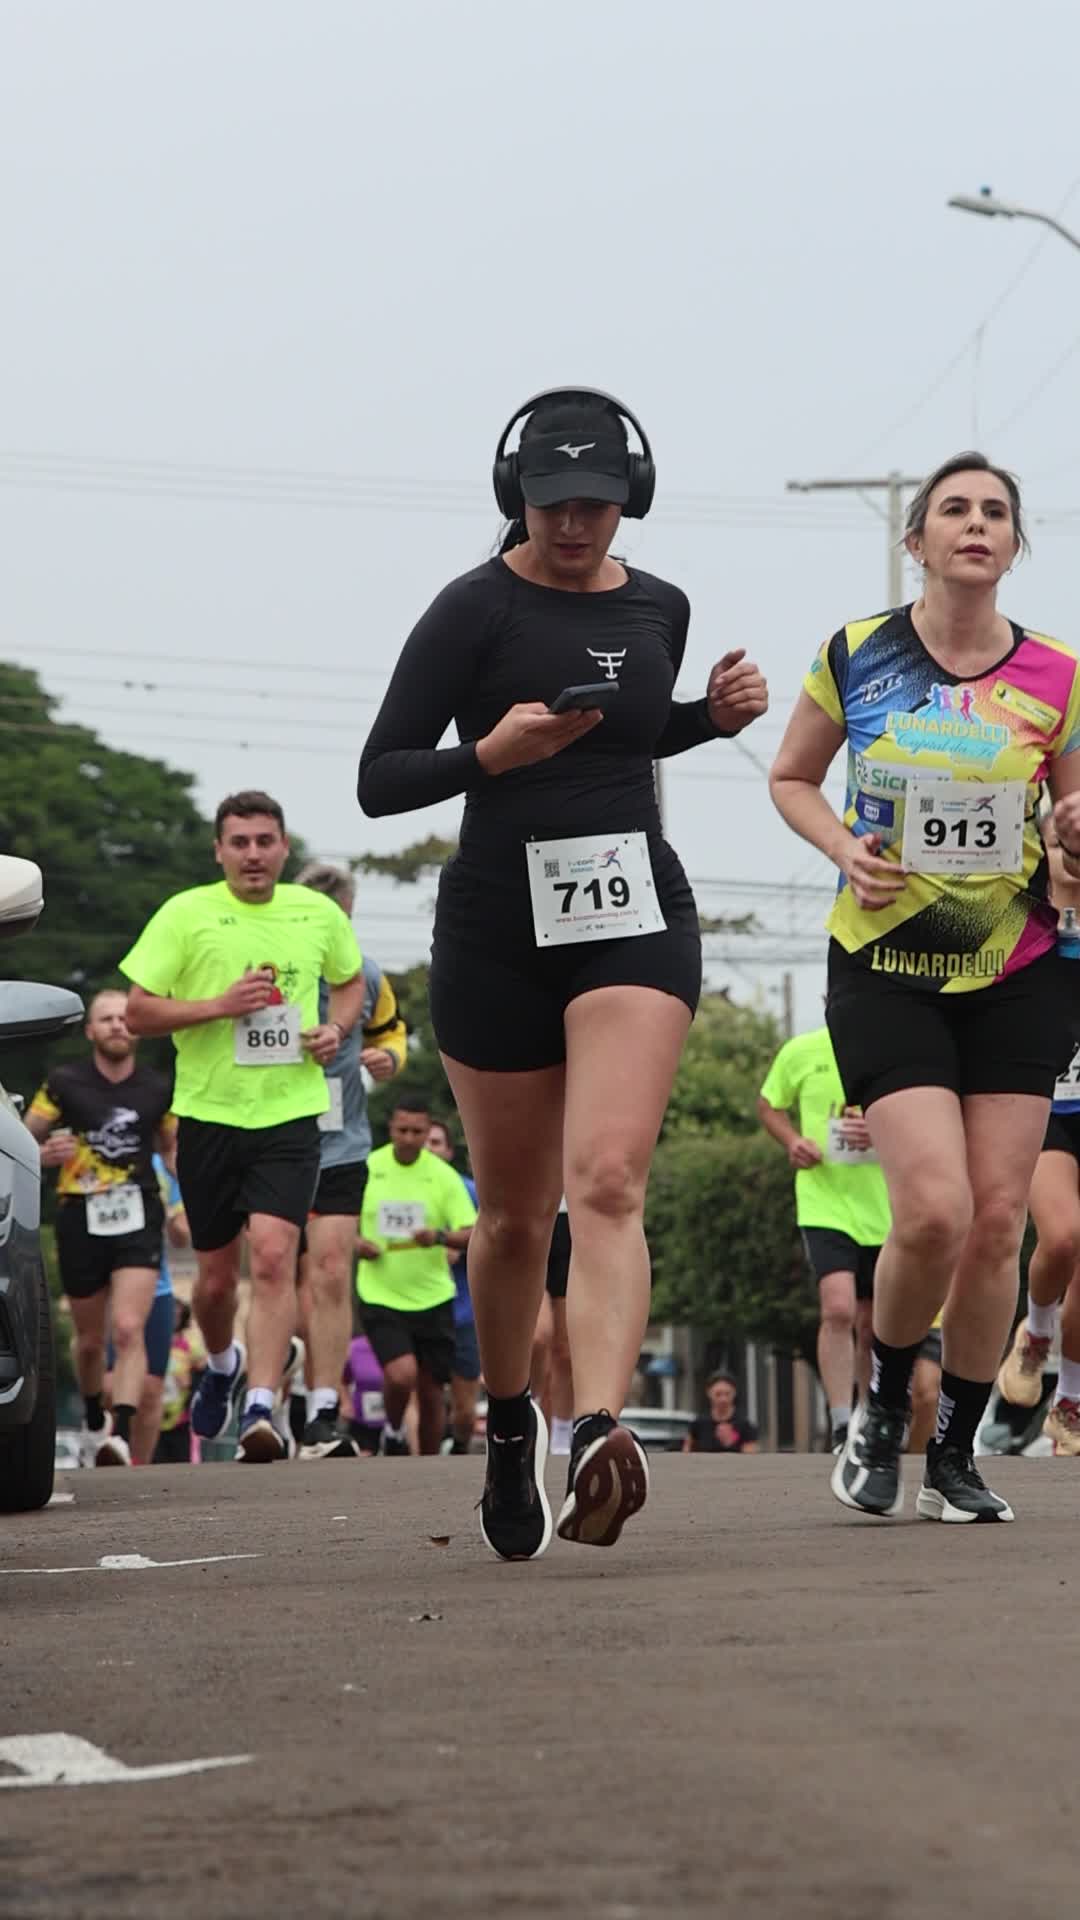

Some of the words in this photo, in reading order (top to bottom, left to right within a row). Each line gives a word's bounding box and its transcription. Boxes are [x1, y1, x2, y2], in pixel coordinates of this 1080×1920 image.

[888, 713, 1008, 747] LUNARDELLI
[923, 817, 997, 849] 913
[552, 876, 631, 914] 719
[871, 945, 1005, 977] LUNARDELLI
[247, 1028, 290, 1048] 860
